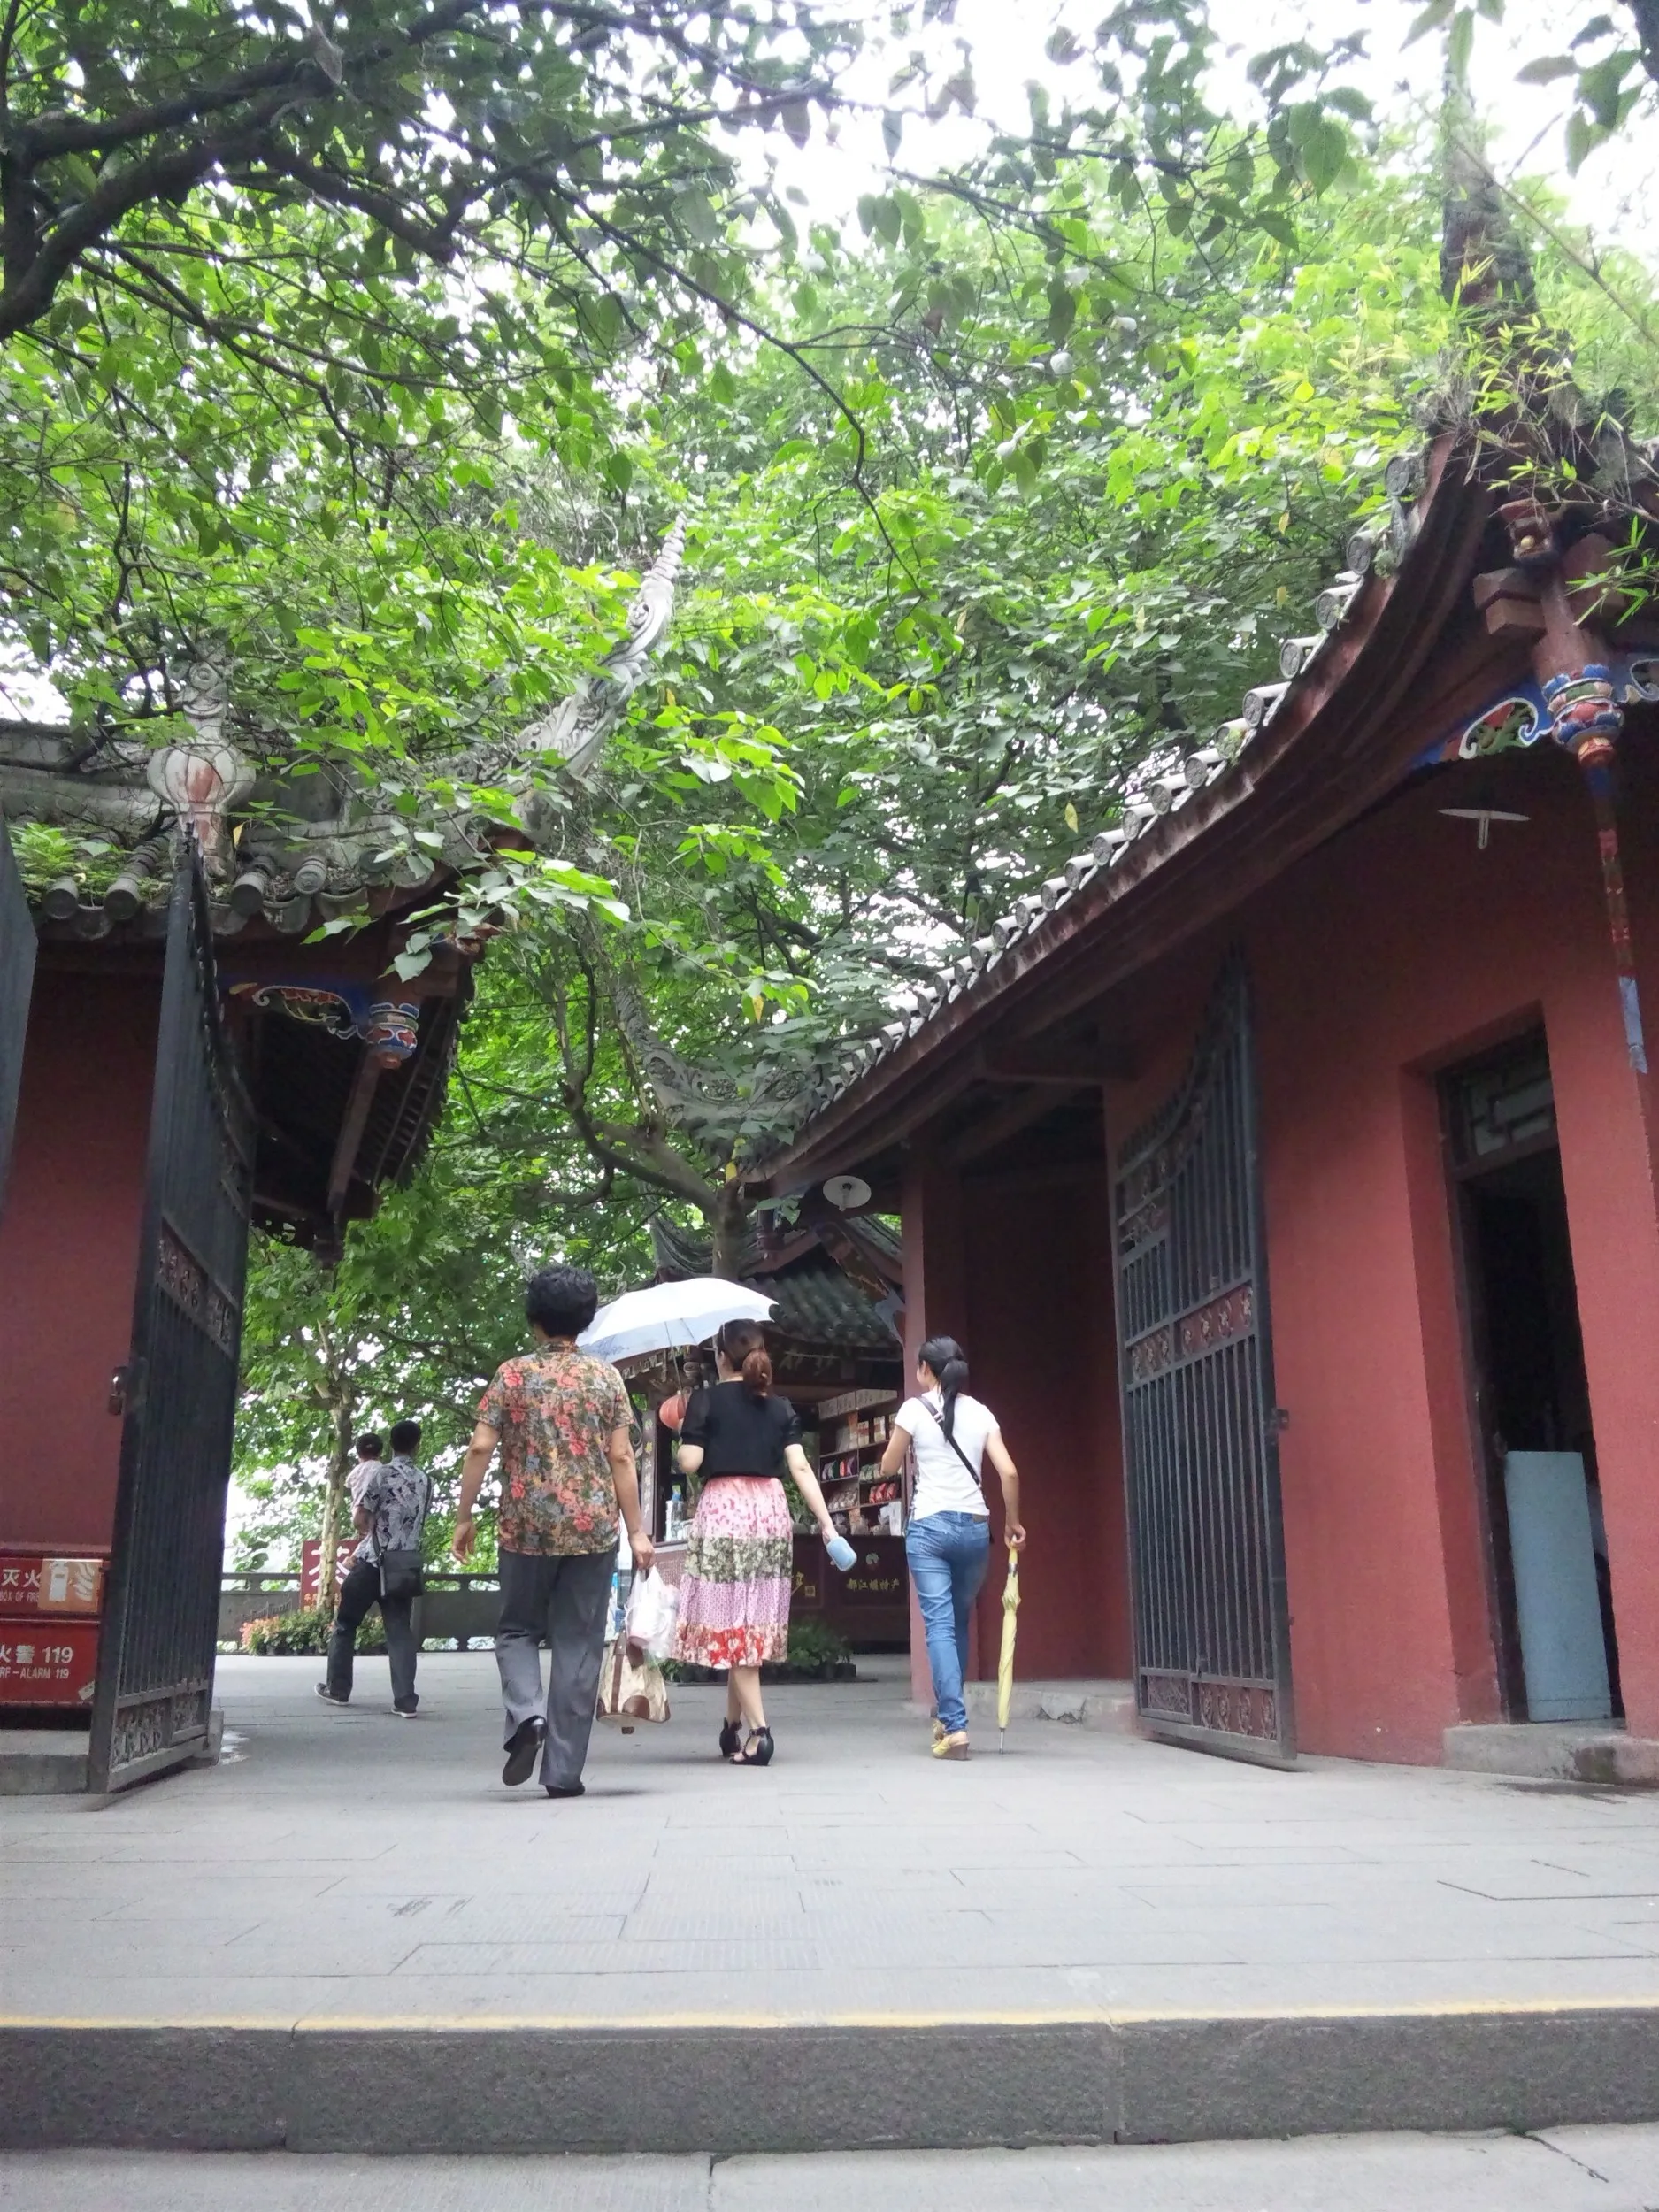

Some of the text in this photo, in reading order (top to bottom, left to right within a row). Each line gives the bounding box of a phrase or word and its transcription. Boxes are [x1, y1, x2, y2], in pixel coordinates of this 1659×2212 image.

[1, 1569, 42, 1588] 灭火
[42, 1646, 73, 1664] 119
[55, 1668, 70, 1679] 119
